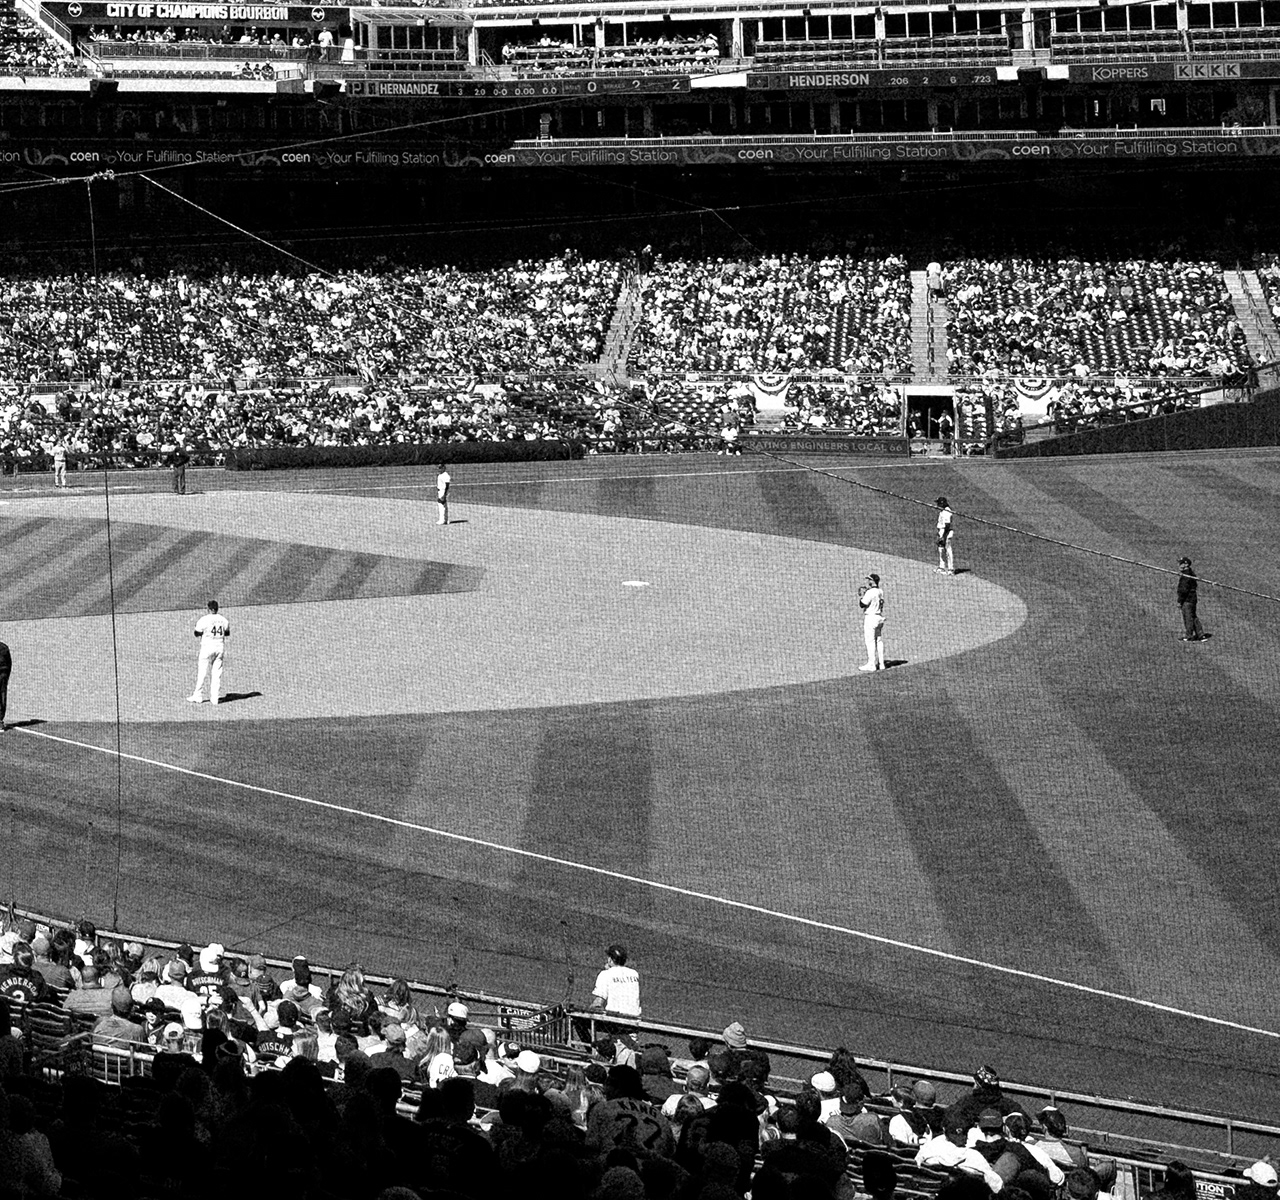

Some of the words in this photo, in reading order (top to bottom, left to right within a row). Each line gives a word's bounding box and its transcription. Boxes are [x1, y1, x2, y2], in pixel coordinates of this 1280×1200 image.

[107, 3, 134, 17] CITY
[137, 4, 154, 17] OF
[157, 4, 228, 19] CHAMPIONS
[230, 6, 289, 20] BOURBON
[1093, 67, 1148, 80] KOPPERS
[1179, 66, 1190, 77] K
[1195, 65, 1205, 76] K
[1211, 65, 1221, 76] K
[1226, 65, 1237, 75] K
[380, 83, 440, 95] HERNANDEZ
[587, 82, 596, 92] 0
[672, 80, 679, 90] 2
[790, 74, 869, 86] HENDERSON
[888, 77, 908, 85] .206
[950, 76, 956, 84] 6
[971, 75, 991, 83] .723
[738, 147, 774, 160] coen
[795, 147, 830, 160] Your
[833, 144, 891, 161] Fulfilling
[895, 143, 948, 158] Station
[1011, 143, 1051, 156] coen
[1073, 141, 1109, 155] Your
[1114, 139, 1177, 157] Fulfilling
[1182, 138, 1238, 153] Station
[70, 150, 100, 162] coen
[116, 150, 143, 163] Your
[146, 149, 192, 165] Fulfilling
[195, 150, 235, 163] Station
[281, 151, 311, 163] coen
[326, 151, 353, 164] Your
[355, 150, 399, 166] Fulfilling
[402, 151, 440, 164] Station
[484, 151, 516, 163] coen
[535, 150, 566, 164] Your
[571, 148, 627, 165] Fulfilling
[630, 147, 678, 162] Station
[791, 441, 849, 451] ENGINEERS
[852, 442, 885, 451] LOCAL
[890, 443, 903, 452] 66
[211, 626, 224, 637] 44
